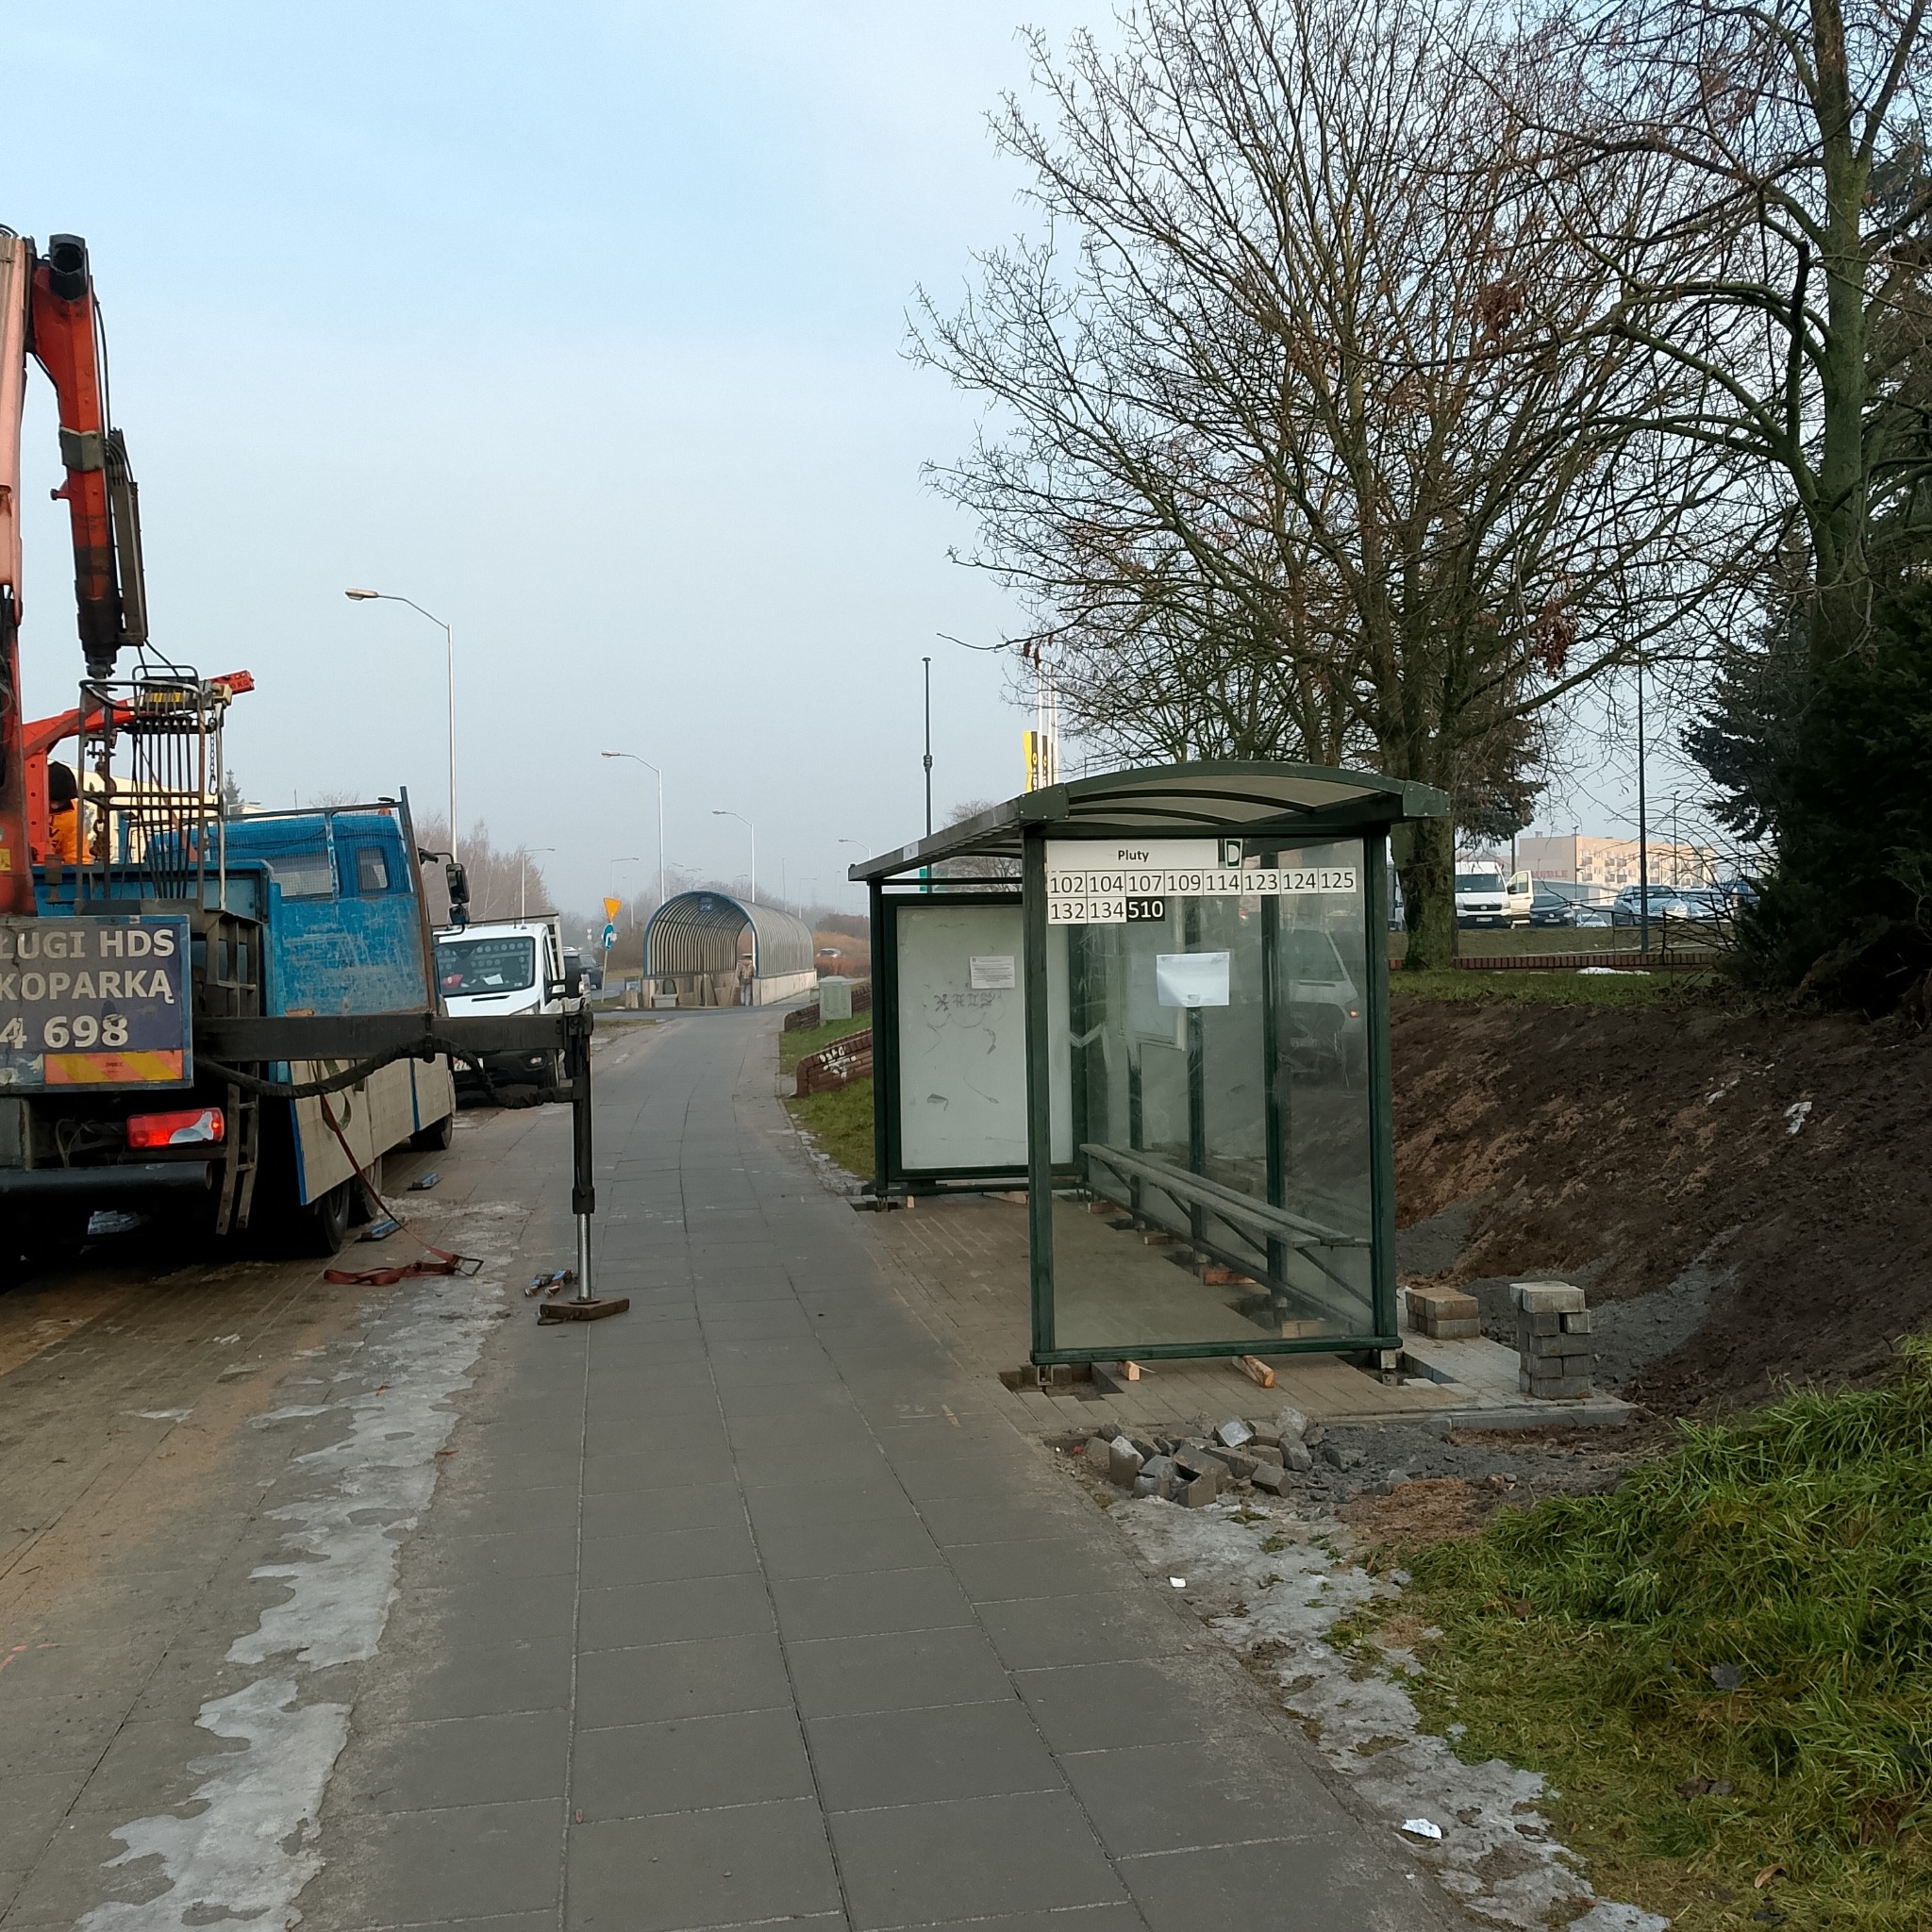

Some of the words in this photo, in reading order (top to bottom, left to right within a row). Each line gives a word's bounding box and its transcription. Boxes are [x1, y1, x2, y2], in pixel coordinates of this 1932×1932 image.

[1119, 850, 1149, 862] Pluty
[1051, 877, 1084, 892] 102
[1091, 876, 1124, 891] 104
[1129, 875, 1161, 891] 107
[1169, 875, 1200, 891] 109
[1207, 874, 1239, 891] 114
[1245, 874, 1277, 891] 123
[1284, 874, 1316, 889] 124
[1322, 873, 1353, 888] 125
[1052, 903, 1084, 919] 132
[1091, 902, 1124, 918] 134
[1128, 901, 1163, 918] 510
[99, 929, 175, 958] HDS
[0, 970, 175, 1005] KOPARKĄ
[0, 1017, 27, 1049] 4
[43, 1013, 128, 1049] 698
